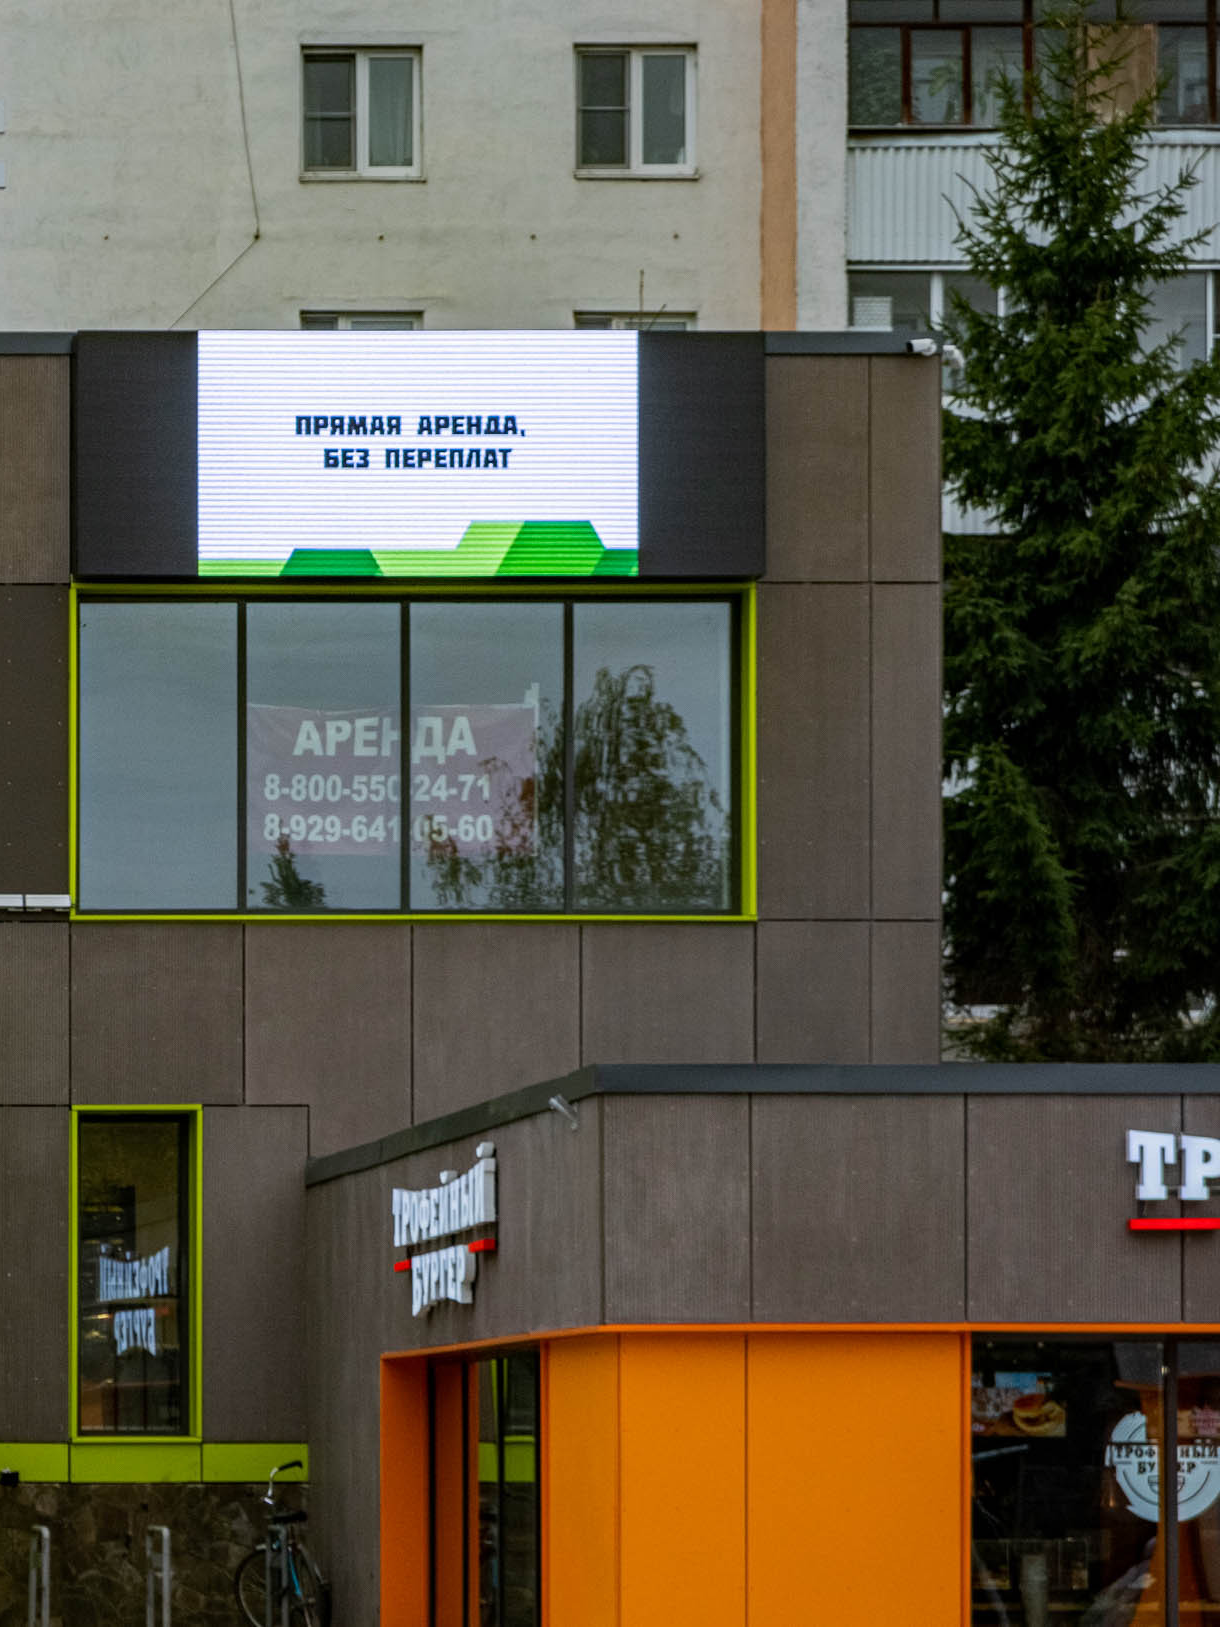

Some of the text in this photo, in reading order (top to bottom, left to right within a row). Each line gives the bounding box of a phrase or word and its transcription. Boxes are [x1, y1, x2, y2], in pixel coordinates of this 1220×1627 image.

[295, 415, 527, 437] ПРЯМАЯ АРЕНДА,
[323, 448, 513, 469] БЕЗ ПЕРЕПЛАТ
[292, 716, 478, 765] АРЕНДА
[263, 773, 491, 802] 8-800-55024-71
[263, 813, 494, 843] 8-929-64105-60
[391, 1141, 496, 1248] ТРОФЕЙНЫЙ
[410, 1243, 477, 1318] БУРГЕР
[1115, 1445, 1219, 1459] ТРОФНЫЙ
[1136, 1461, 1197, 1475] БУЕР
